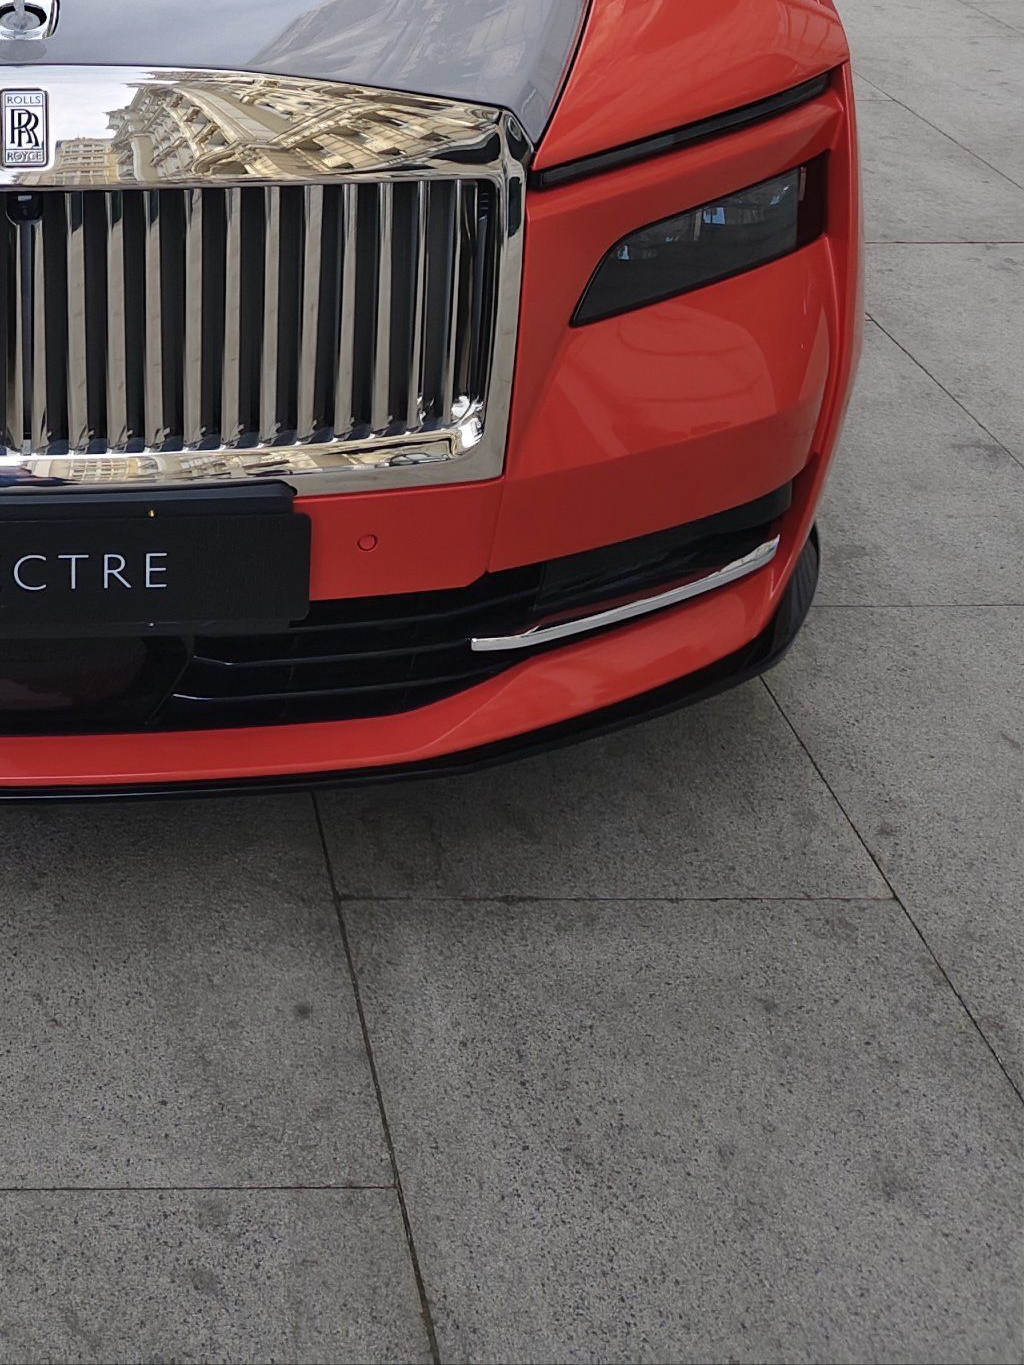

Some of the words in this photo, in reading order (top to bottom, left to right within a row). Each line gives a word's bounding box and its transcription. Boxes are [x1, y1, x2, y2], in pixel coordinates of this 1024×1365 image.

[7, 95, 41, 104] ROLLS
[10, 108, 40, 147] RR
[7, 151, 42, 161] ROYCE
